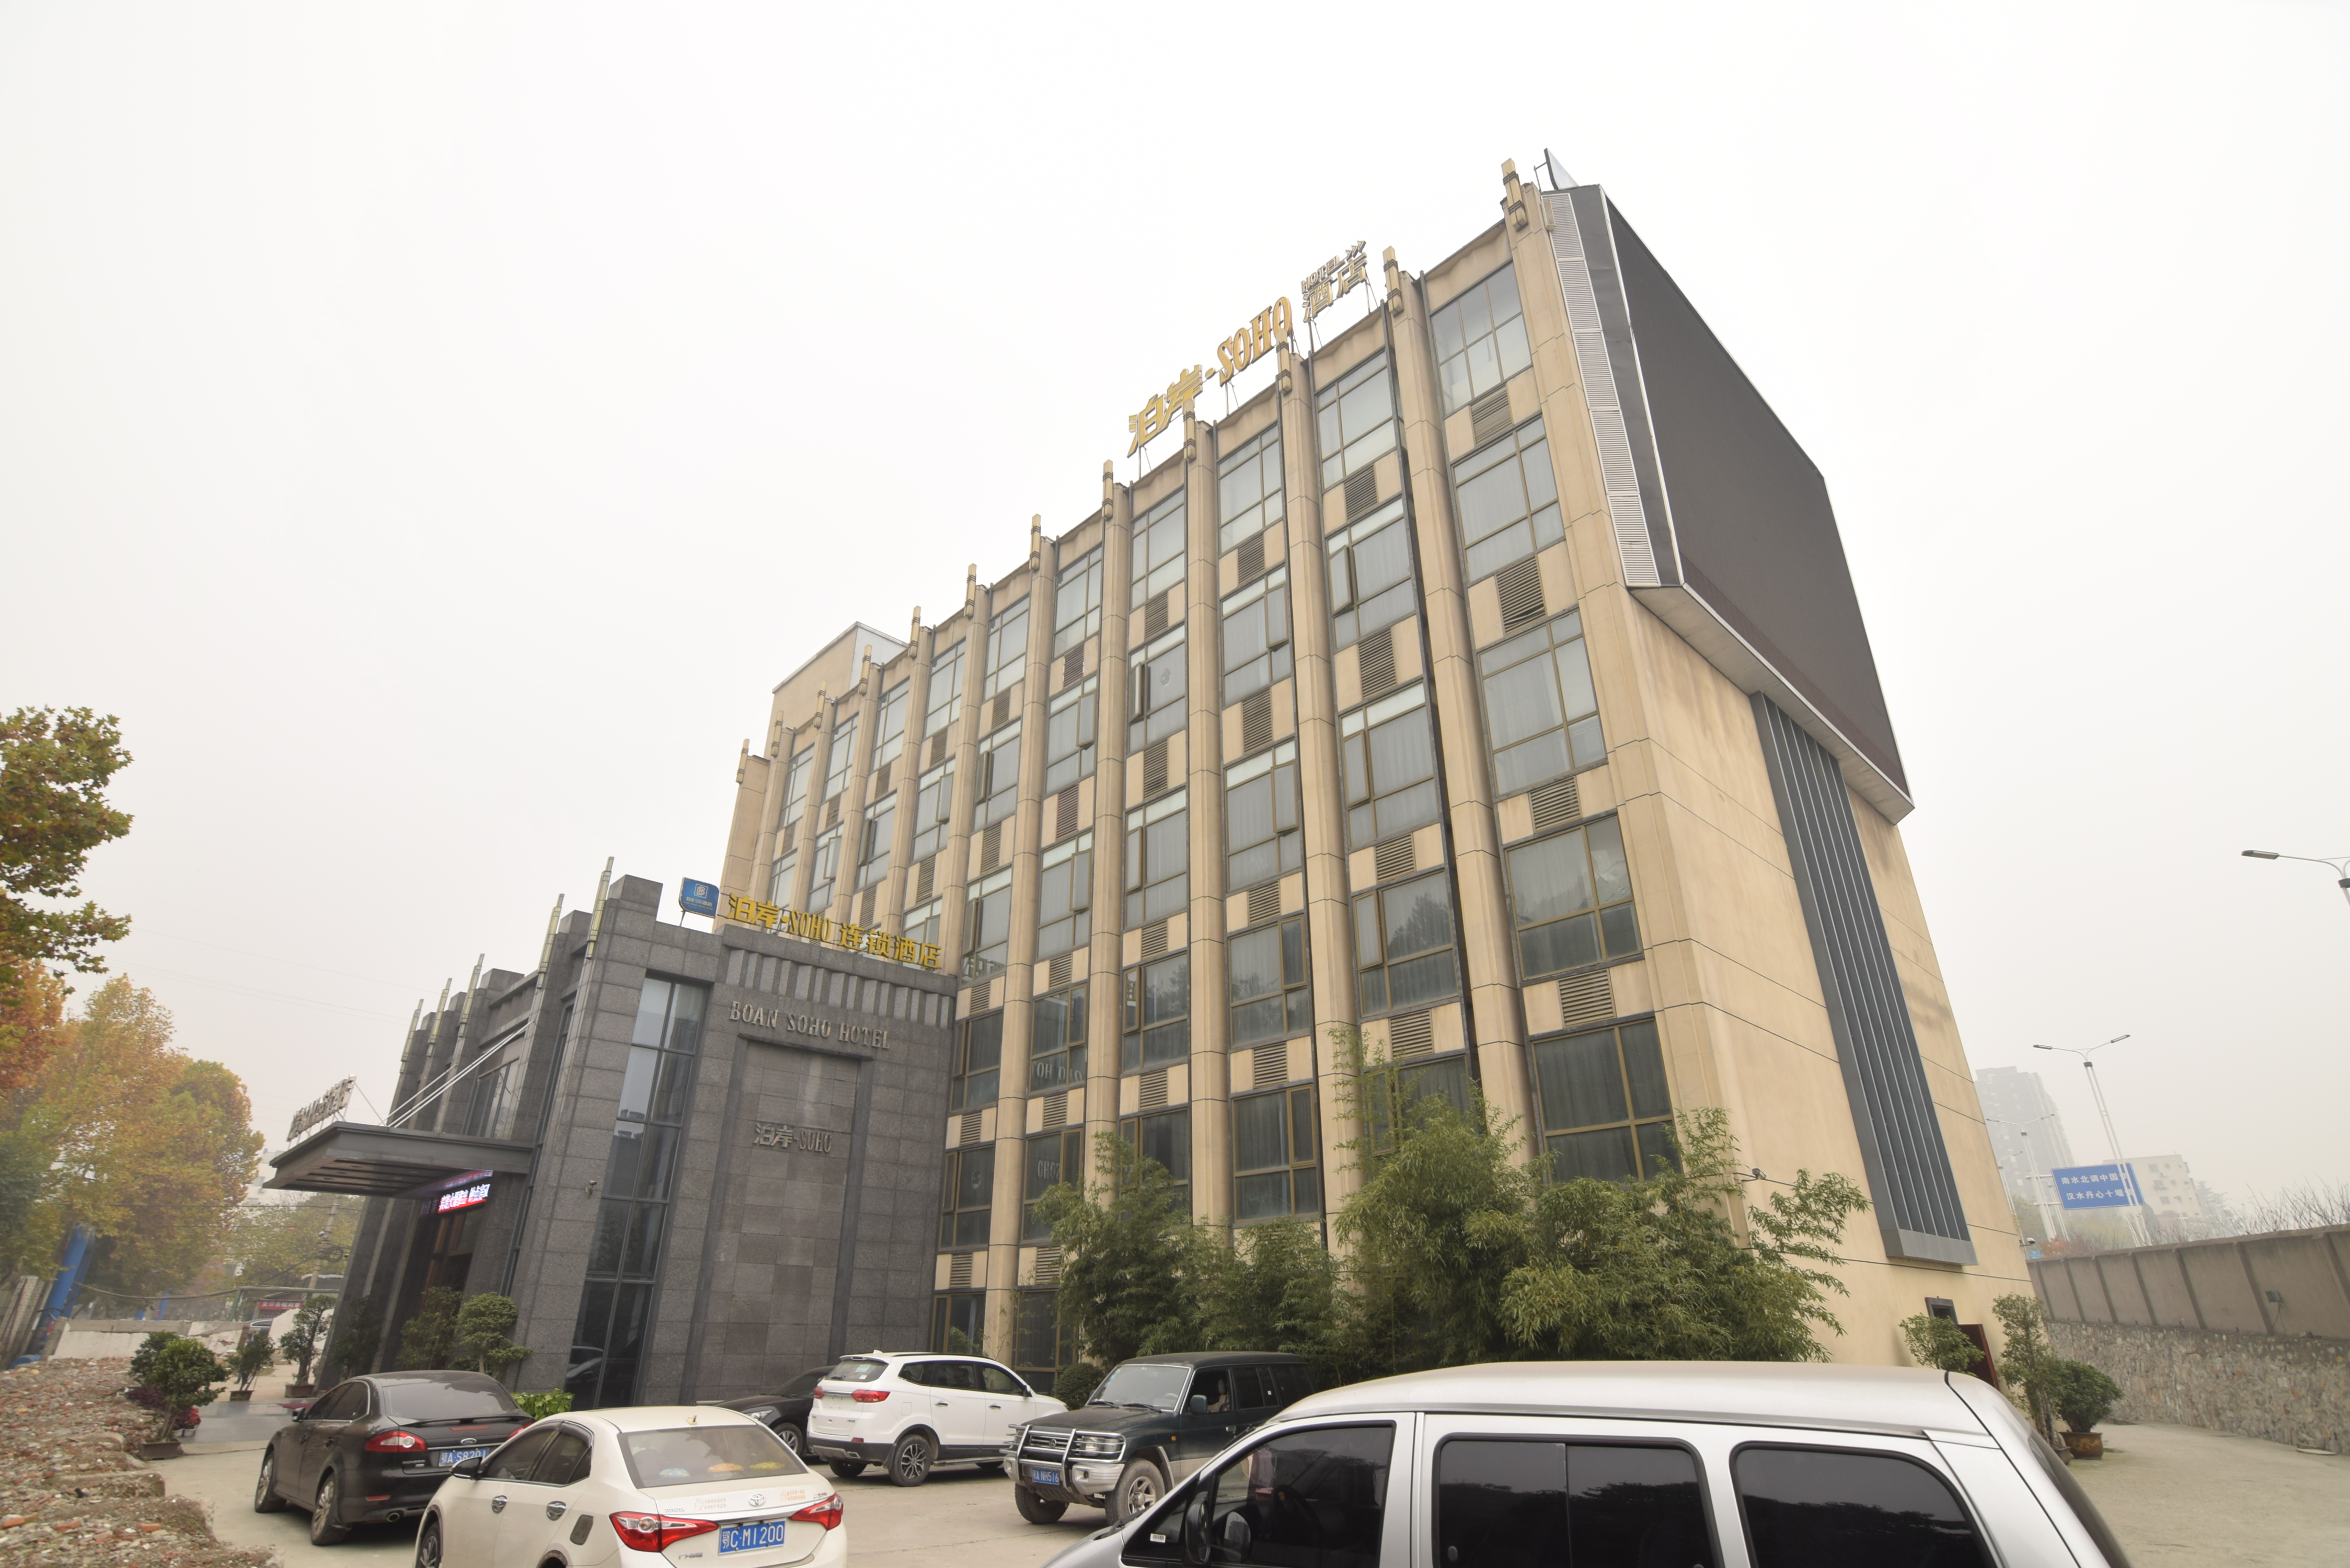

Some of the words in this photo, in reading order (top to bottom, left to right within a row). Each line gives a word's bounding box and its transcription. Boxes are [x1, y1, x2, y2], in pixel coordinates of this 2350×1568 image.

[1301, 256, 1346, 294] HOTEL
[1301, 252, 1367, 323] 酒店
[839, 921, 942, 969] 连锁酒店
[730, 1000, 778, 1028] BOAN
[787, 1012, 831, 1037] SOHO
[838, 1022, 889, 1049] HOTEL
